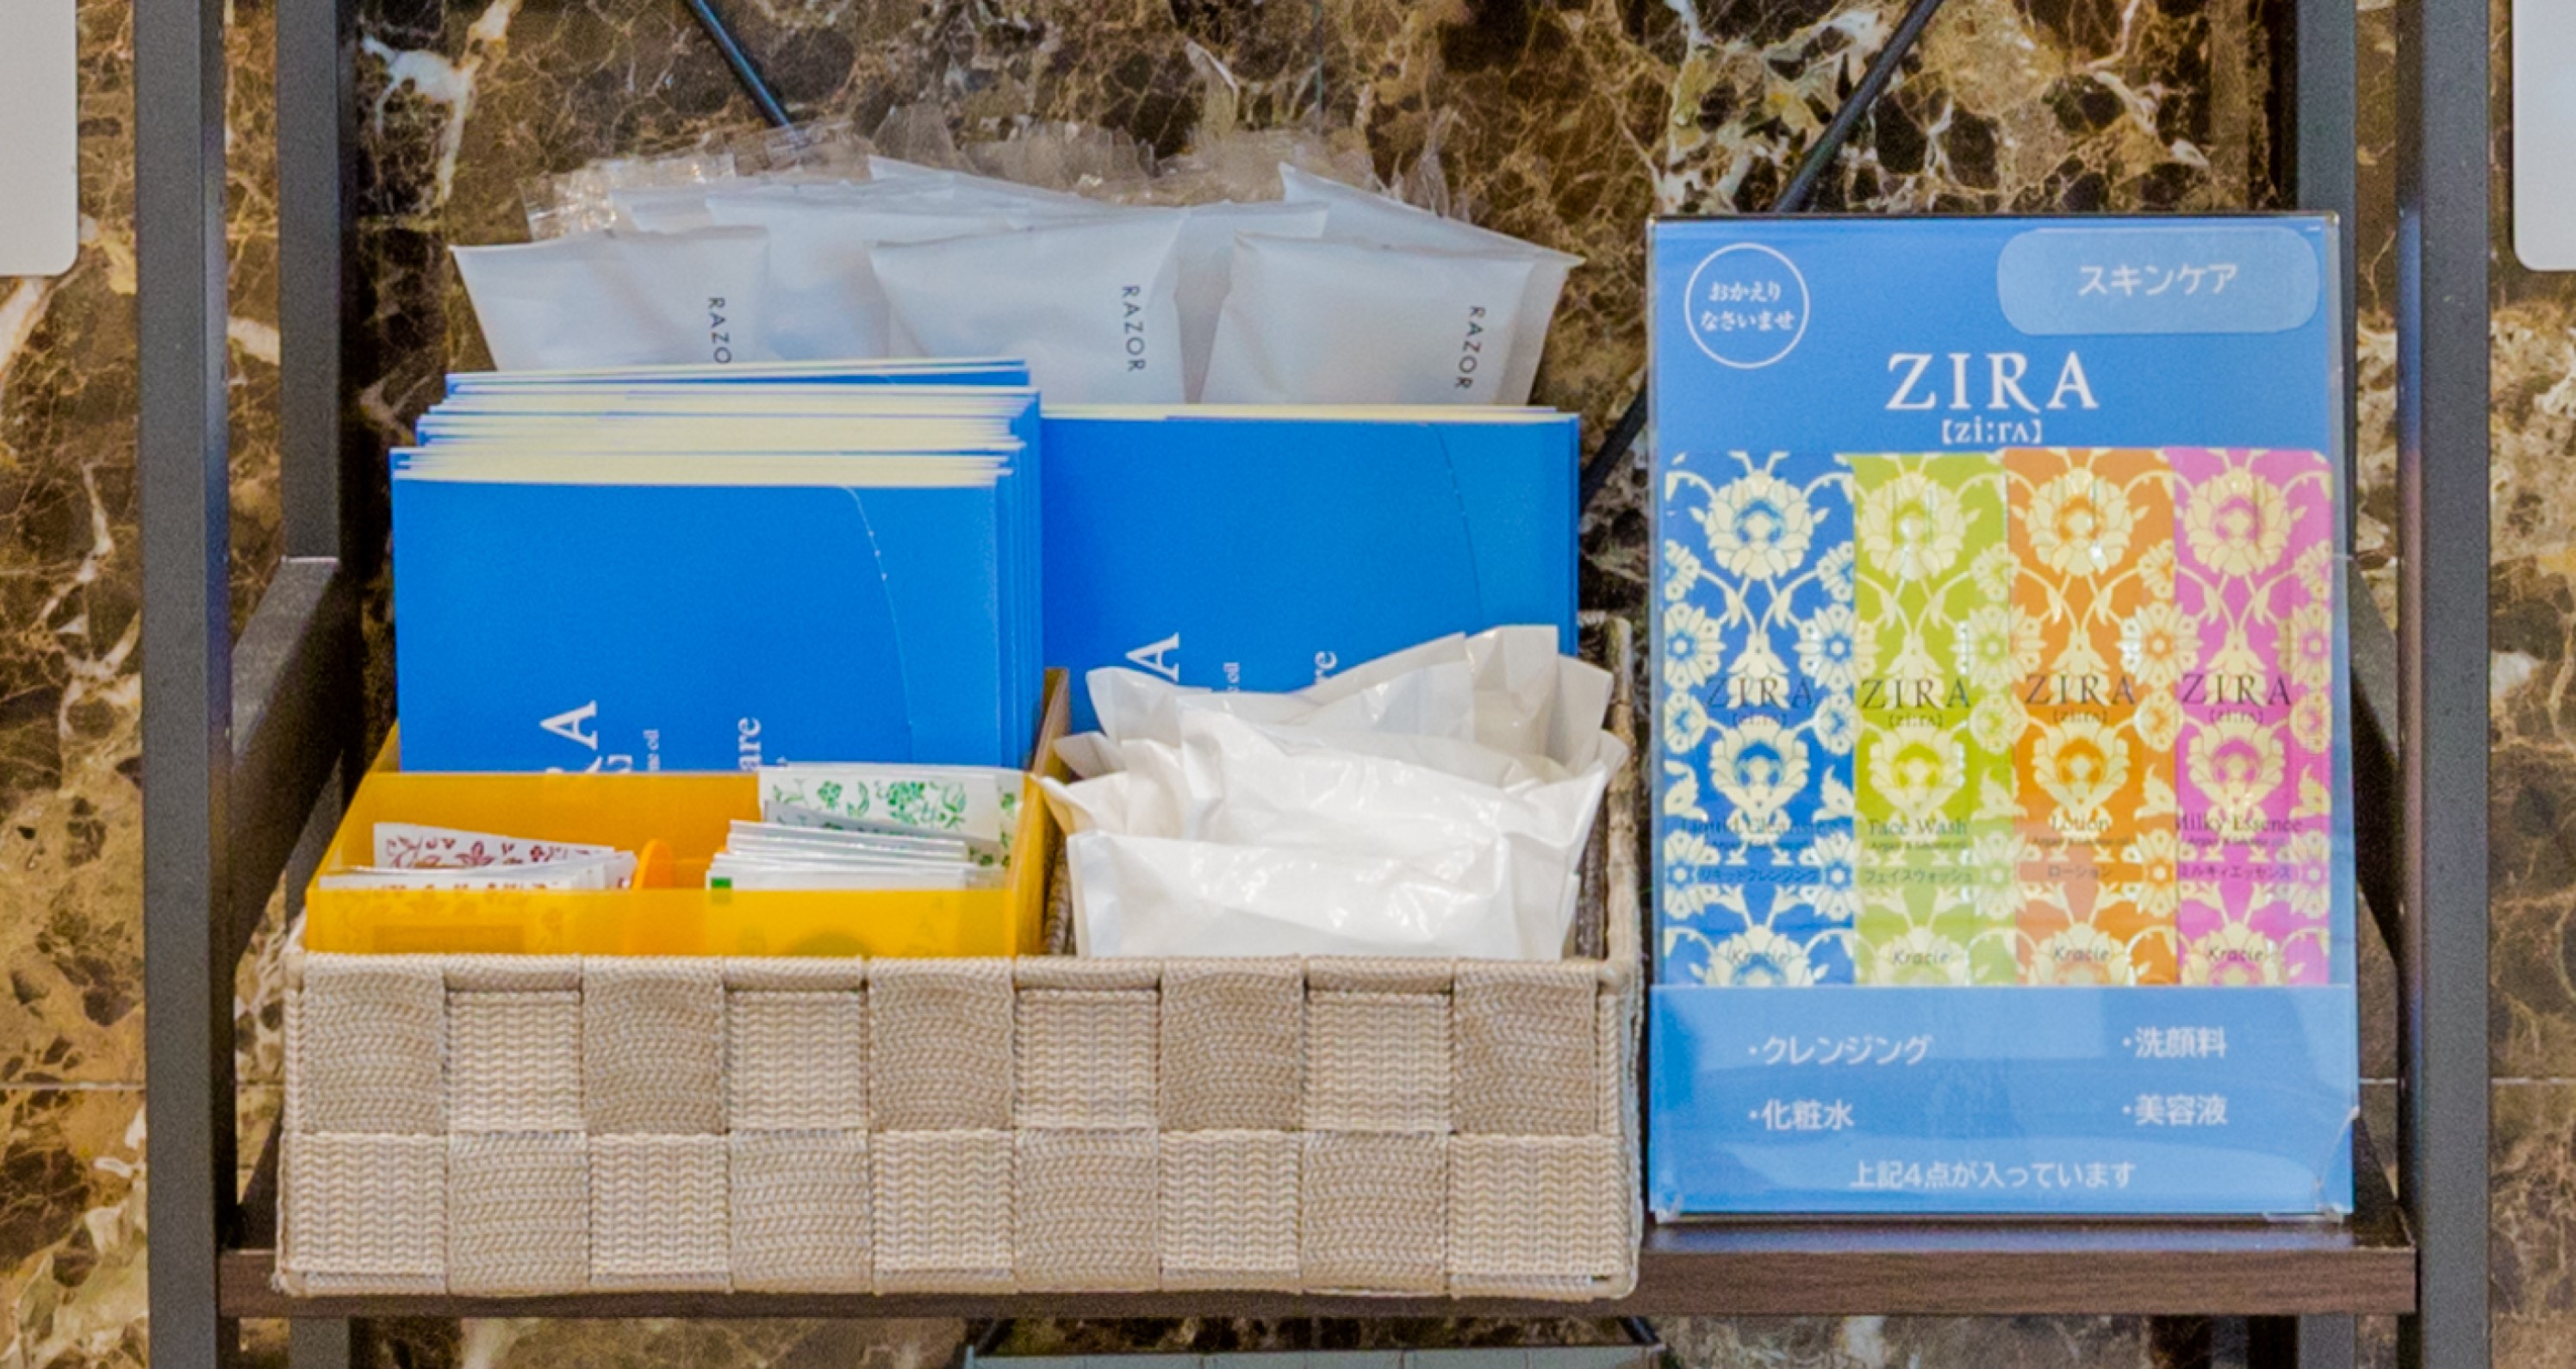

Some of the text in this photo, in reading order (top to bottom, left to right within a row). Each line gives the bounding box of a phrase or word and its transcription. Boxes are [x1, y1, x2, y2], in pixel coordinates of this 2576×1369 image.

[1708, 280, 1782, 302] おかえり
[2078, 264, 2237, 296] スキンケア
[707, 297, 732, 364] RAZO
[1122, 285, 1147, 372] RAZOR
[1701, 310, 1795, 332] なさいませ
[1454, 305, 1486, 389] RAZOR
[1885, 351, 2100, 414] ZIRA
[1125, 632, 1179, 685] A
[1705, 678, 1813, 708] ZIRA
[1862, 679, 1970, 710] ZIRA
[2026, 673, 2136, 706] ZIRA
[2183, 674, 2293, 706] ZIRA
[737, 716, 762, 771] are
[1869, 816, 1967, 836] Face Wash
[2050, 815, 2109, 833] Lotion
[2233, 814, 2303, 833] Essence
[1864, 868, 1974, 886] フェイスウォッシュ
[2047, 865, 2113, 881] ローション
[1893, 949, 1950, 966] Kracie
[2054, 947, 2110, 963] Kracie
[2208, 946, 2264, 962] Kracie
[1849, 1160, 2138, 1191] 上記4点が入っています
